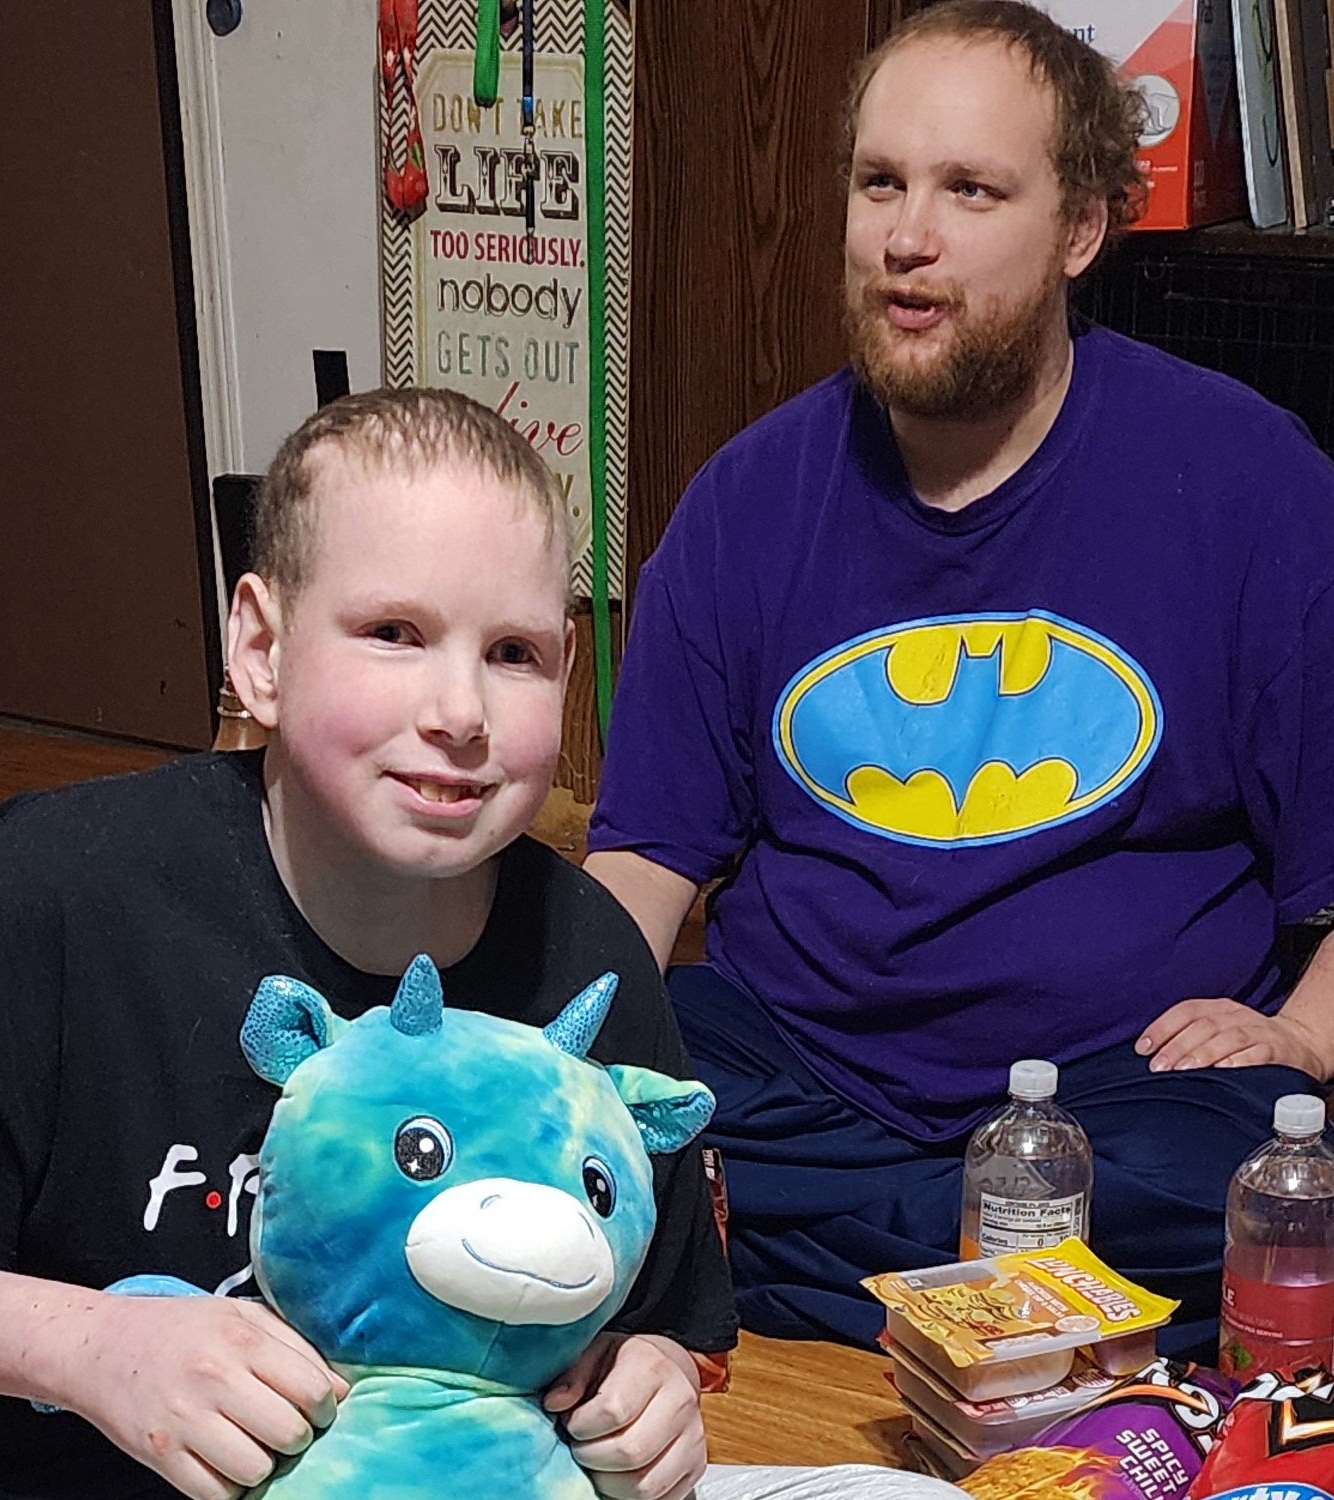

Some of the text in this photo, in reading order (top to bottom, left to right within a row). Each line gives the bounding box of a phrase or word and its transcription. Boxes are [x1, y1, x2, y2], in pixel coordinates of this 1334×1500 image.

[433, 93, 504, 136] DONT
[433, 144, 580, 220] LIFE
[430, 229, 585, 269] TOO SERIOUSLY.
[437, 272, 583, 330] nobody
[437, 330, 580, 384] GETS OUT
[497, 381, 584, 456] live
[983, 1202, 1072, 1218] Nutrition Facts
[1024, 1255, 1143, 1322] LUNCHABLES
[1116, 1430, 1177, 1494] SWEET
[1141, 1428, 1189, 1486] SPICY
